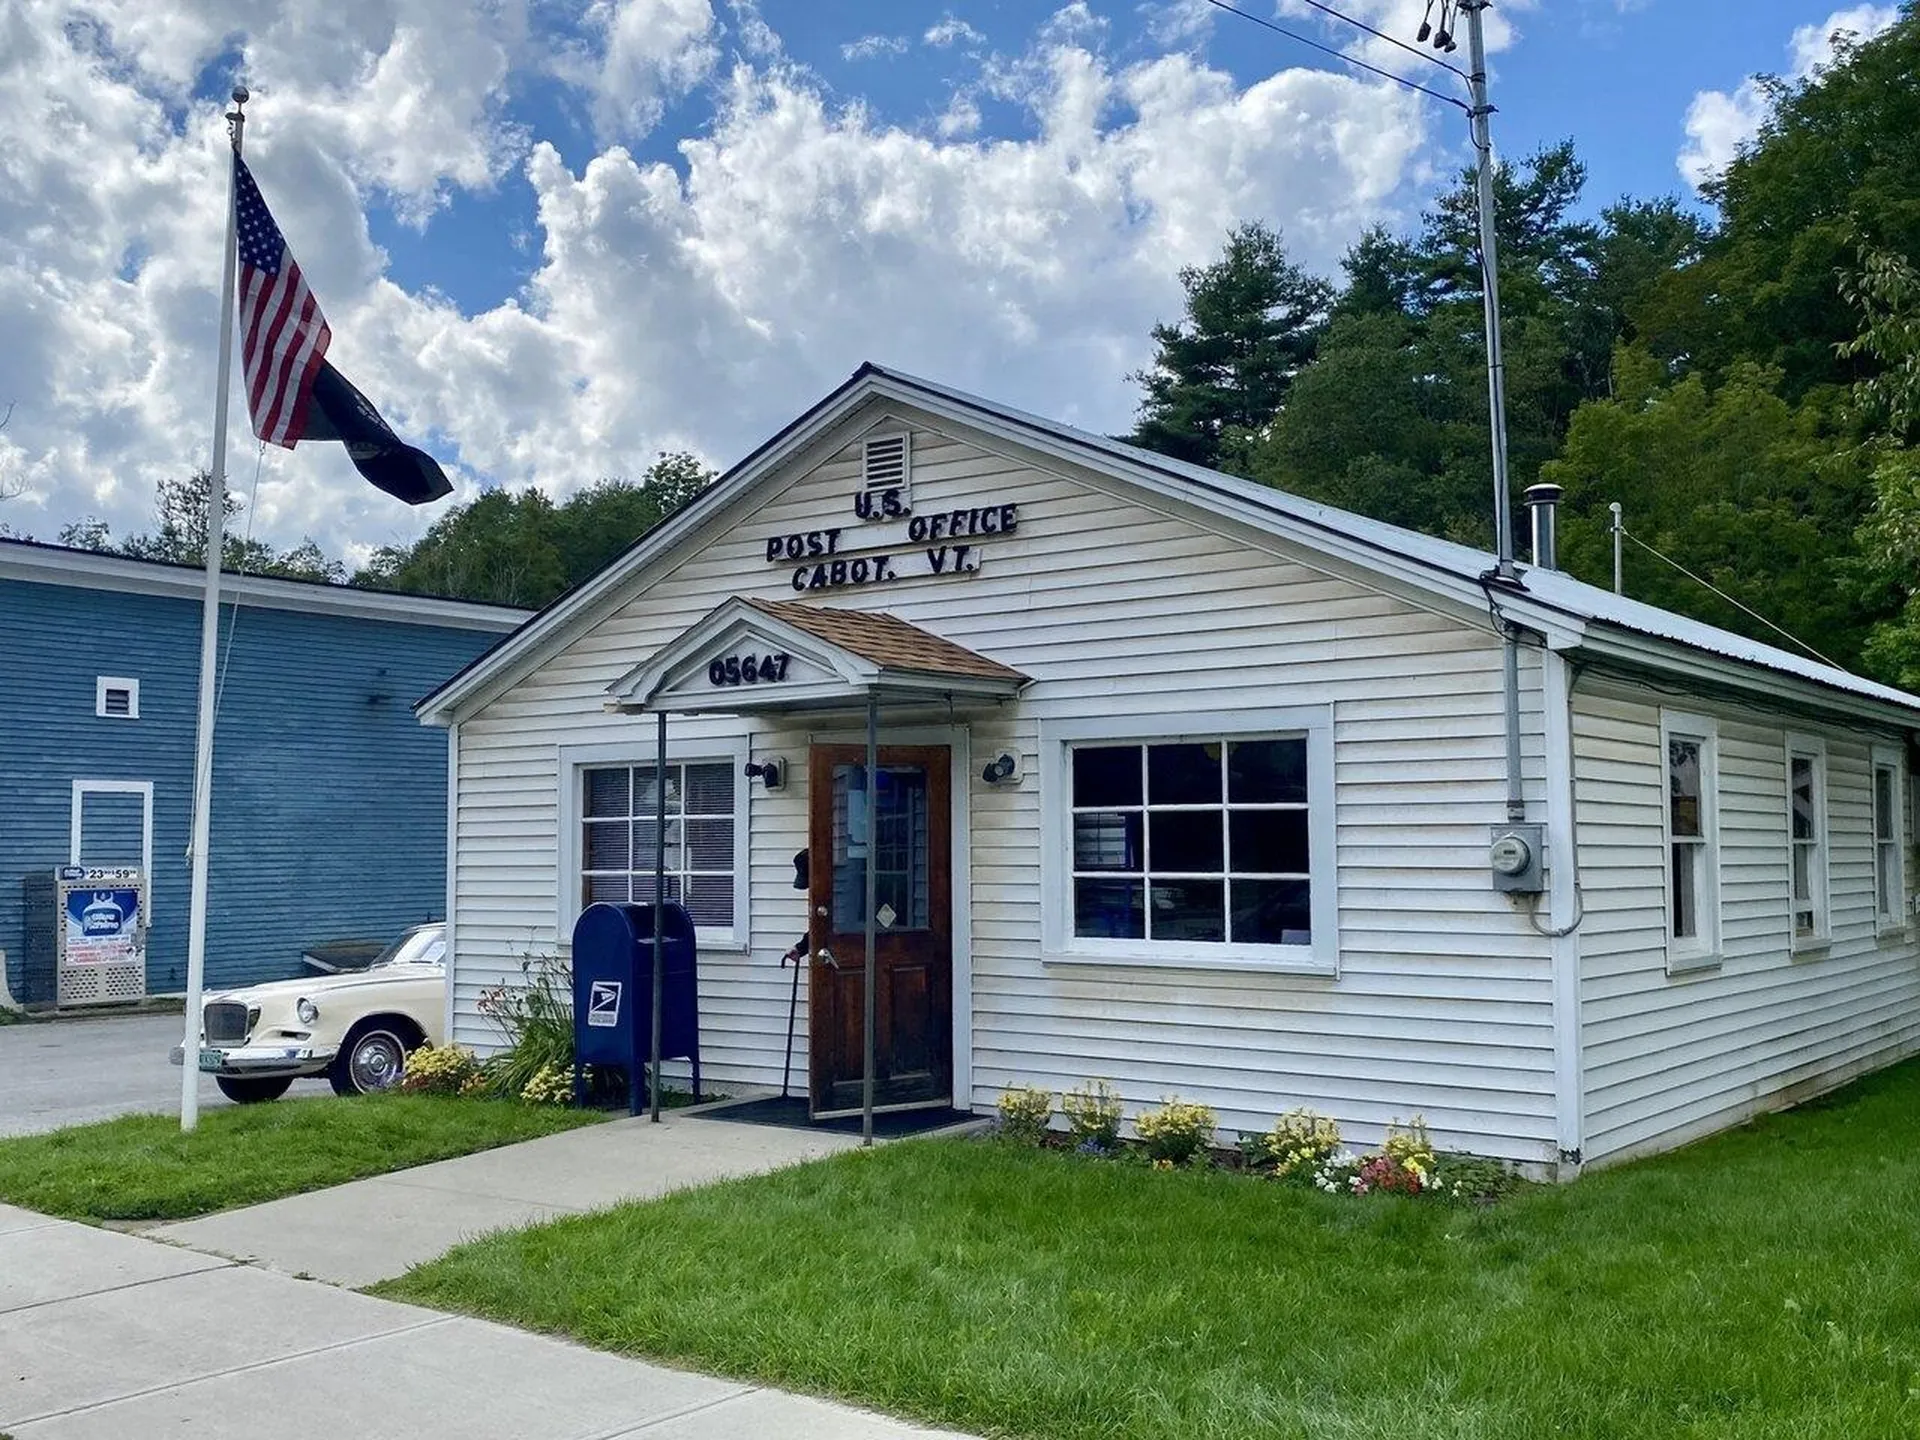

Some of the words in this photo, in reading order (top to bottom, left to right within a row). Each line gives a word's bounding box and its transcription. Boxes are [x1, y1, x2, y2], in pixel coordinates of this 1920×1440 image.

[854, 488, 912, 520] U.S.
[766, 528, 842, 563] POST
[908, 503, 1019, 542] OFFICE
[926, 545, 976, 574] VT.
[708, 651, 790, 686] 05647
